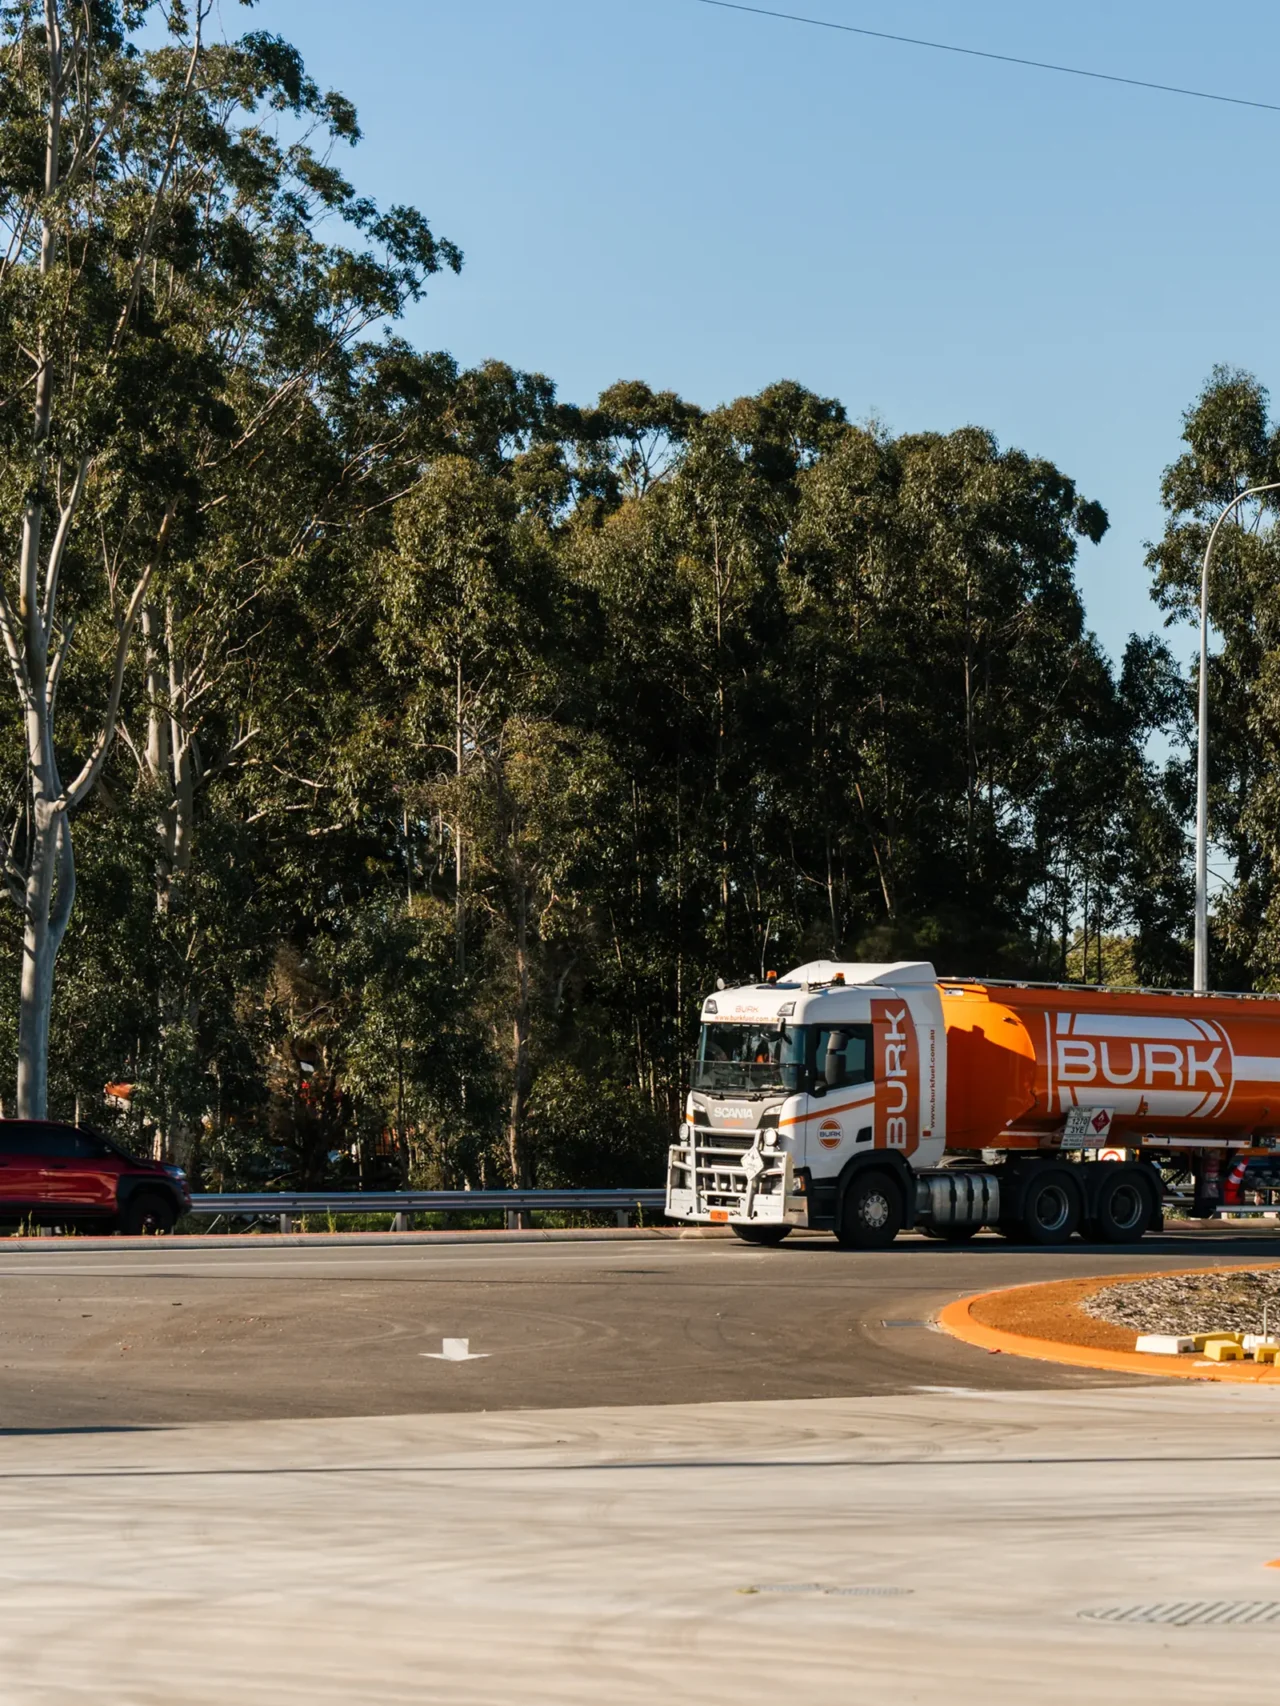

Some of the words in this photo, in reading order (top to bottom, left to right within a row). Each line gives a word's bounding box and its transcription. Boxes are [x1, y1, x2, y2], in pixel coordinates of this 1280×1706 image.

[735, 1005, 759, 1013] BURK
[1057, 1040, 1224, 1087] BURK
[885, 1008, 907, 1149] BURK
[714, 1107, 753, 1119] SCANIA
[819, 1130, 842, 1138] BURK
